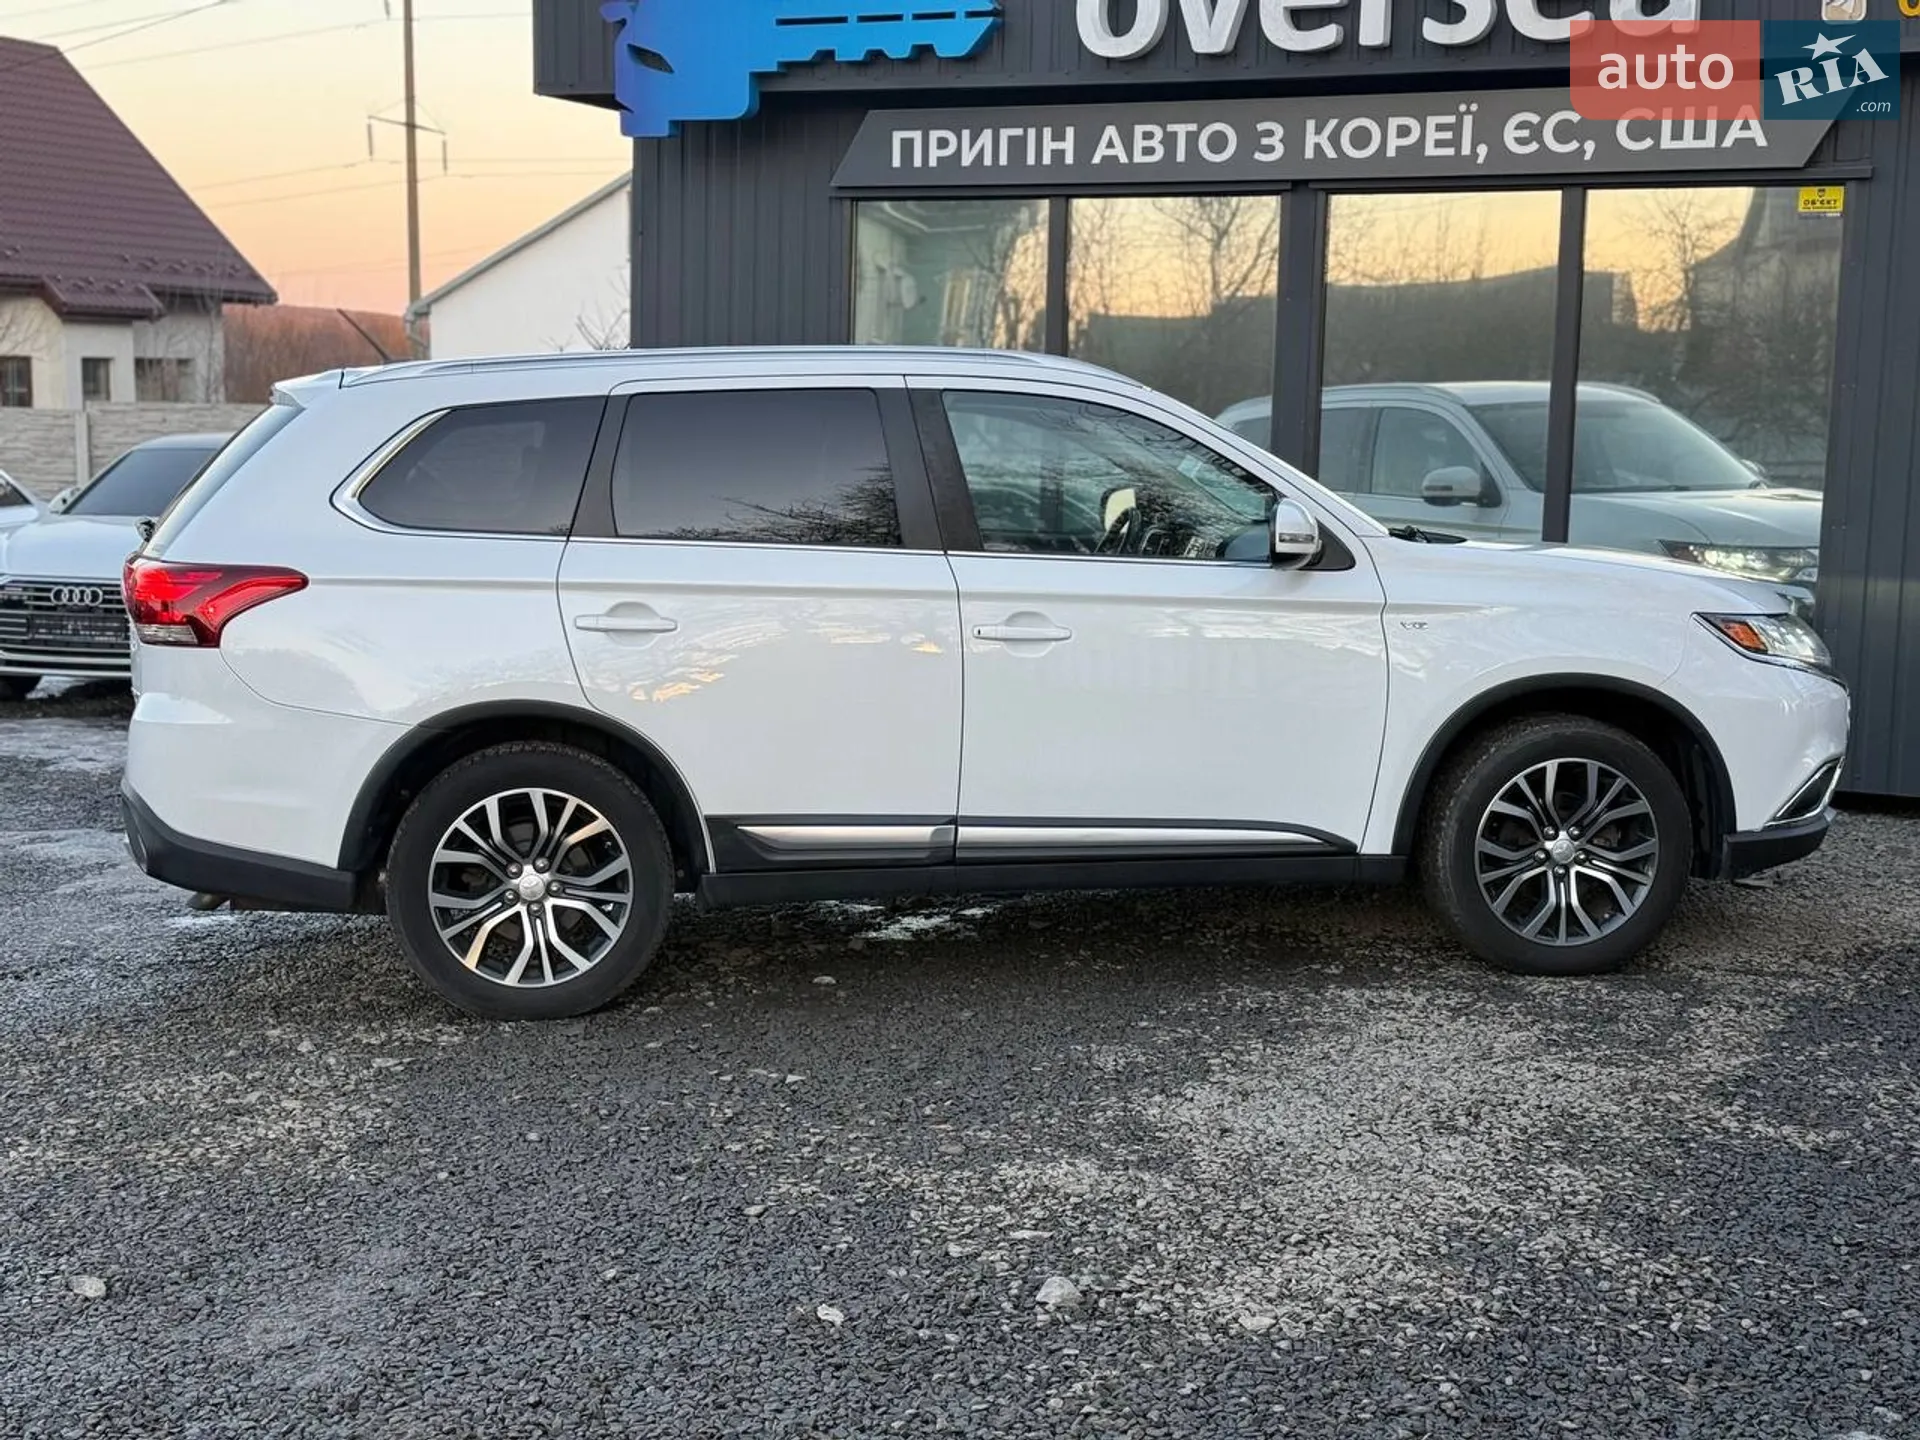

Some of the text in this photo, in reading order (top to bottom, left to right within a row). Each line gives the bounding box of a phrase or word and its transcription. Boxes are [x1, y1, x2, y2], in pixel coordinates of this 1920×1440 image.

[891, 102, 1769, 169] ПРИГІН АВТО З КОРЕЇ, ЄС, США
